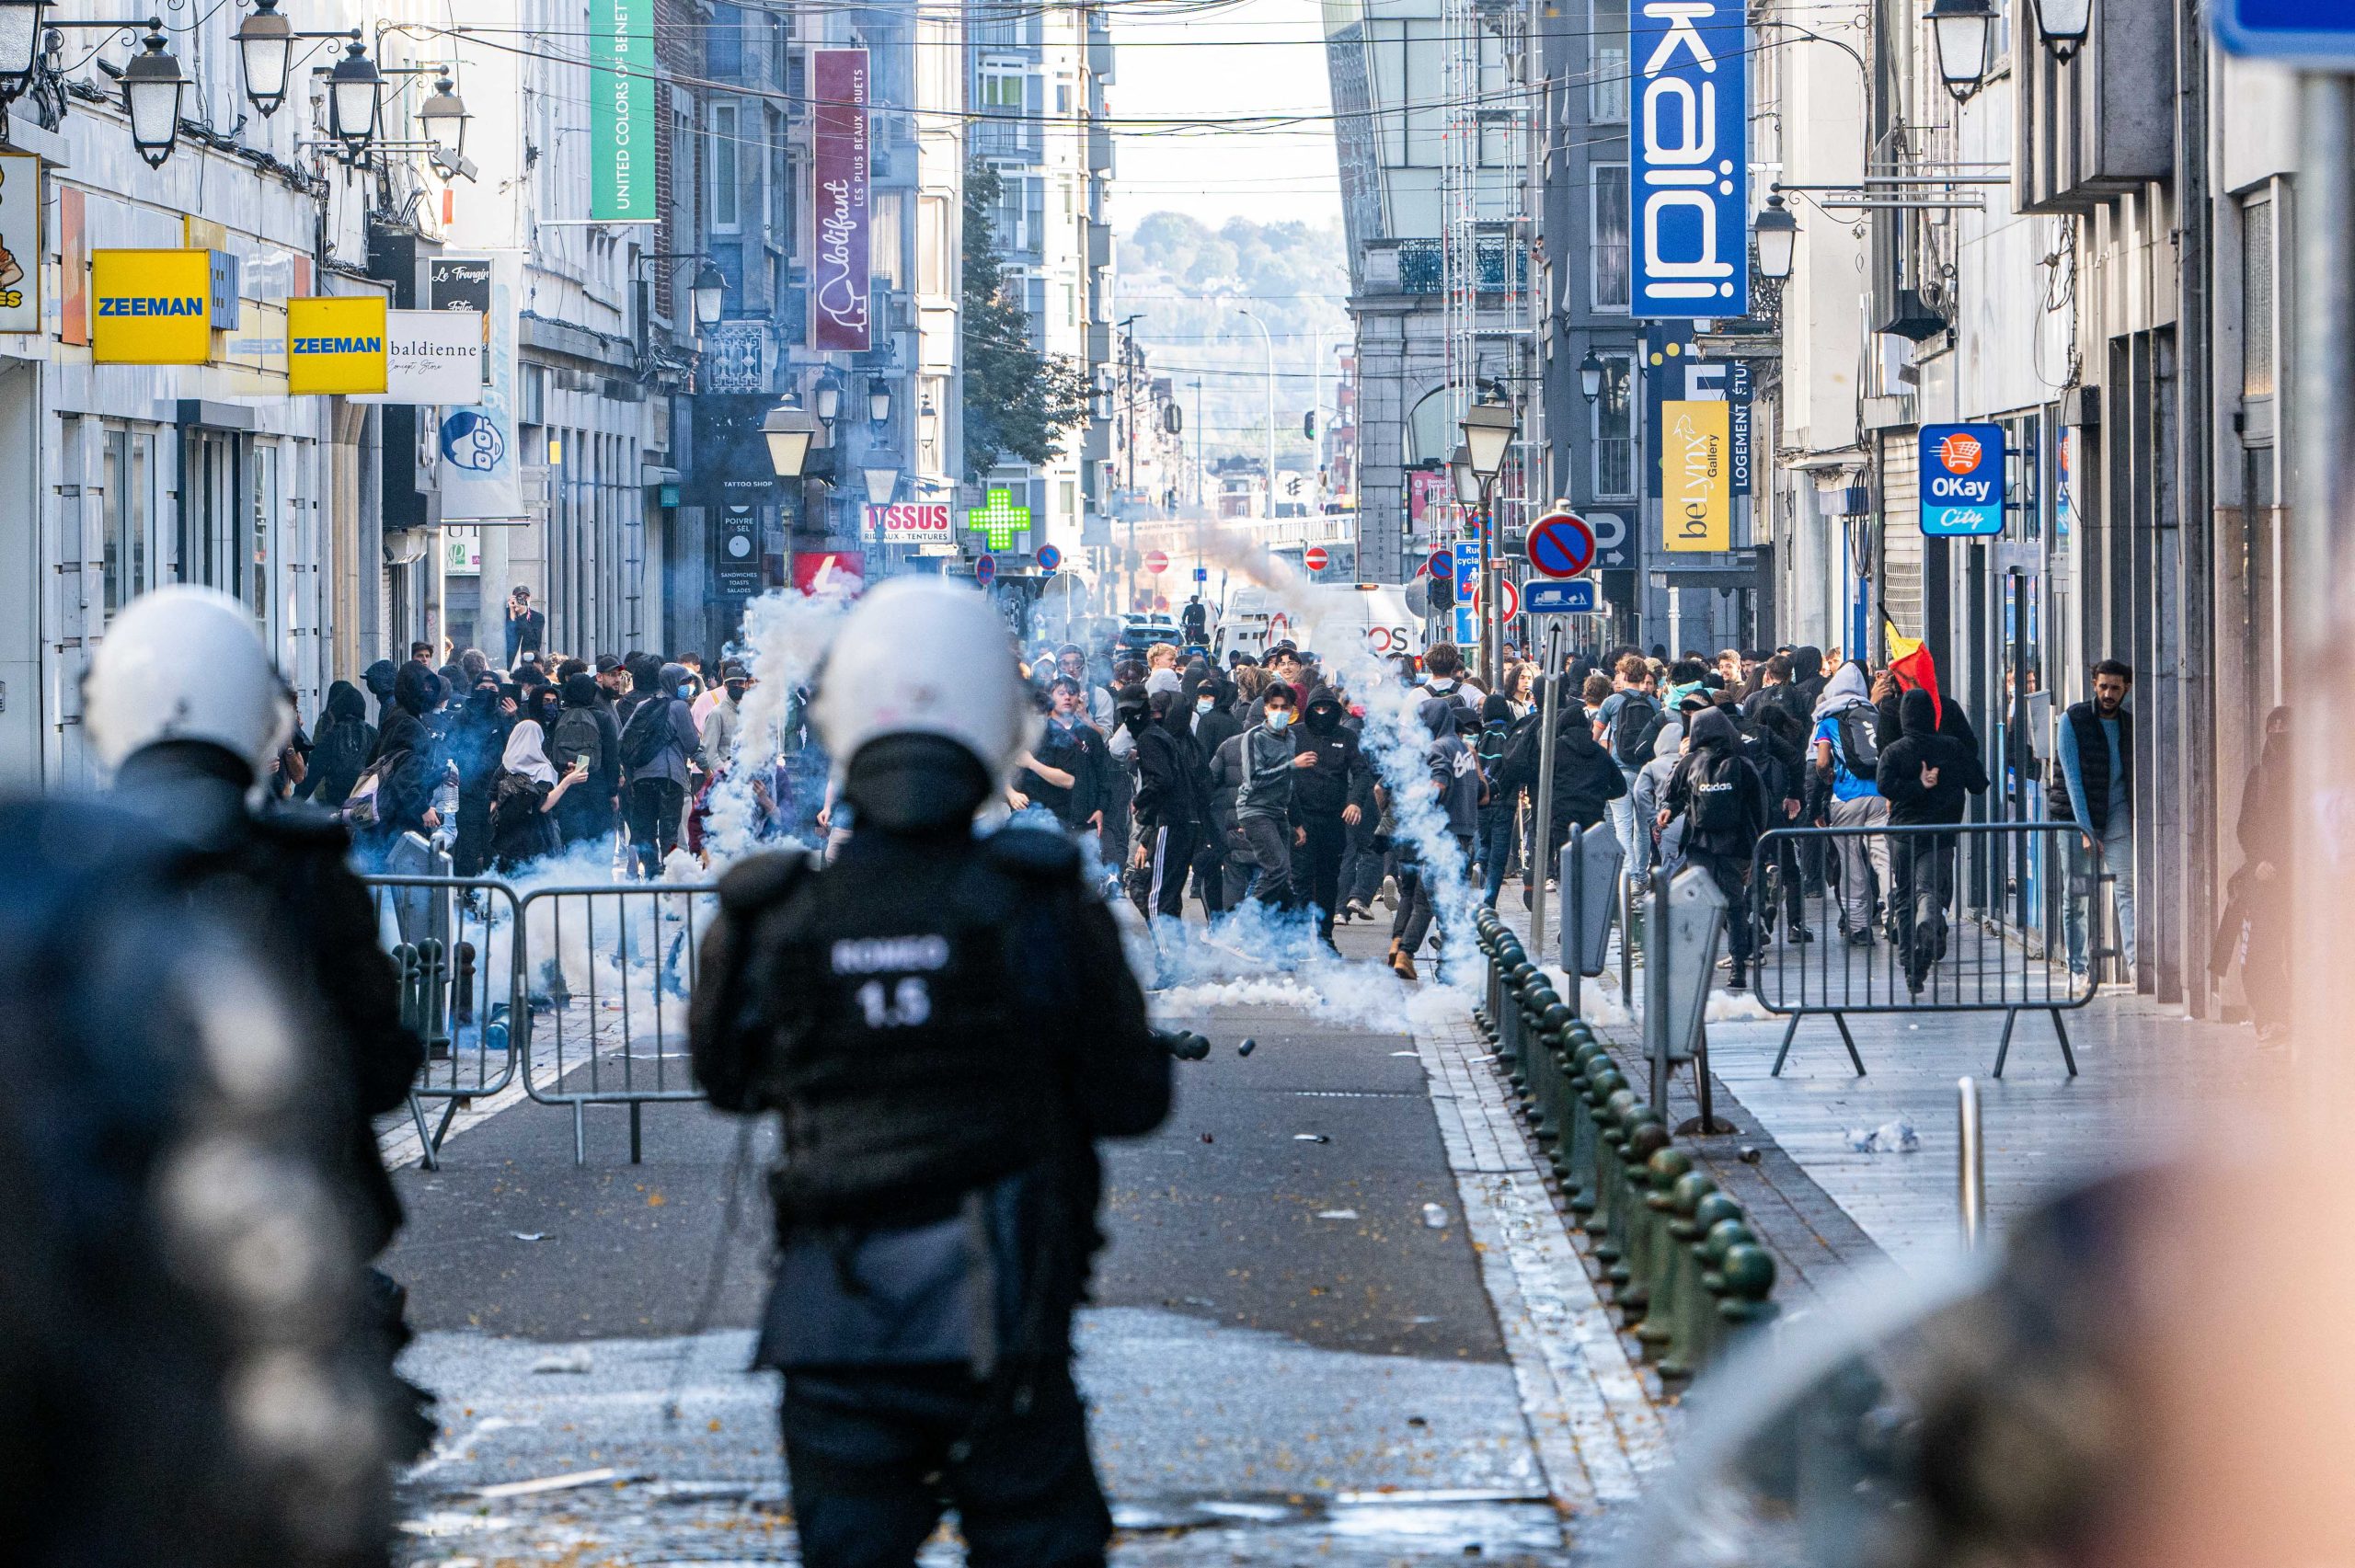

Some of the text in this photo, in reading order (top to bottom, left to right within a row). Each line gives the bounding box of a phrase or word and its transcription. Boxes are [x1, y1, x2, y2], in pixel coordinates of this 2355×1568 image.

[615, 0, 630, 210] UNITED COLORS OF BENET
[854, 115, 864, 150] BEAUX
[854, 155, 864, 182] PLUS
[854, 188, 864, 207] LES
[431, 267, 450, 282] Le
[98, 297, 202, 315] ZEEMAN
[293, 337, 381, 354] ZEEMAN
[1707, 434, 1719, 478] Gallery
[1735, 404, 1748, 486] LOGEMENT
[1932, 477, 1991, 502] OKay
[1940, 509, 1984, 530] City
[1585, 513, 1626, 566] P
[1457, 555, 1485, 567] cycla
